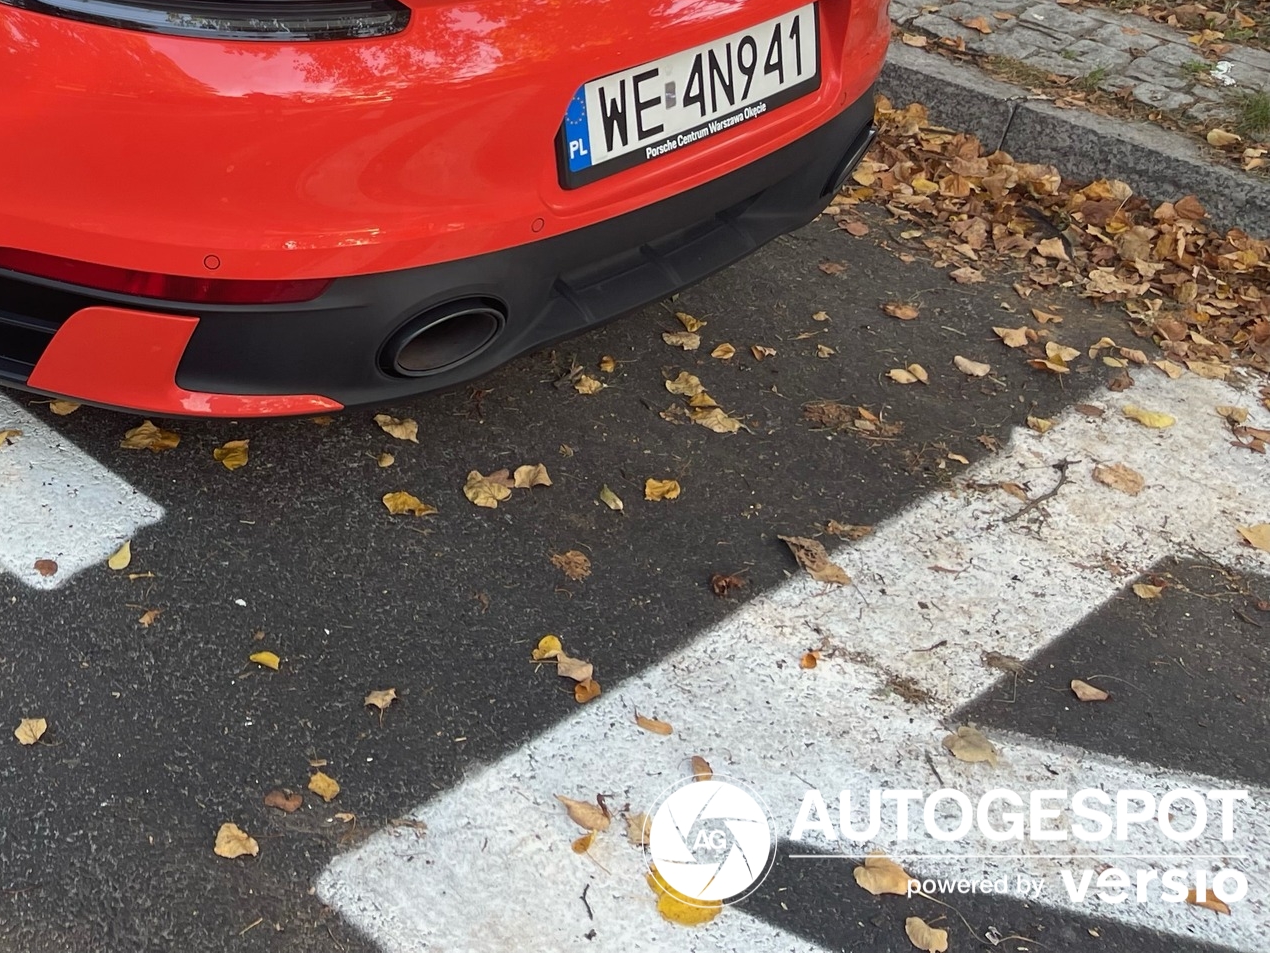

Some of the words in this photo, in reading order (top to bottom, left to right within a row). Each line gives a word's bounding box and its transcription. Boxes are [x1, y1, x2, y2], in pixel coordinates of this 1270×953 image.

[598, 68, 665, 153] WE
[683, 14, 802, 118] 4N941
[569, 139, 588, 160] PL
[645, 140, 678, 160] Porsche
[677, 127, 709, 147] Centrum
[708, 114, 745, 135] Warszawa
[743, 101, 767, 119] Okęcie
